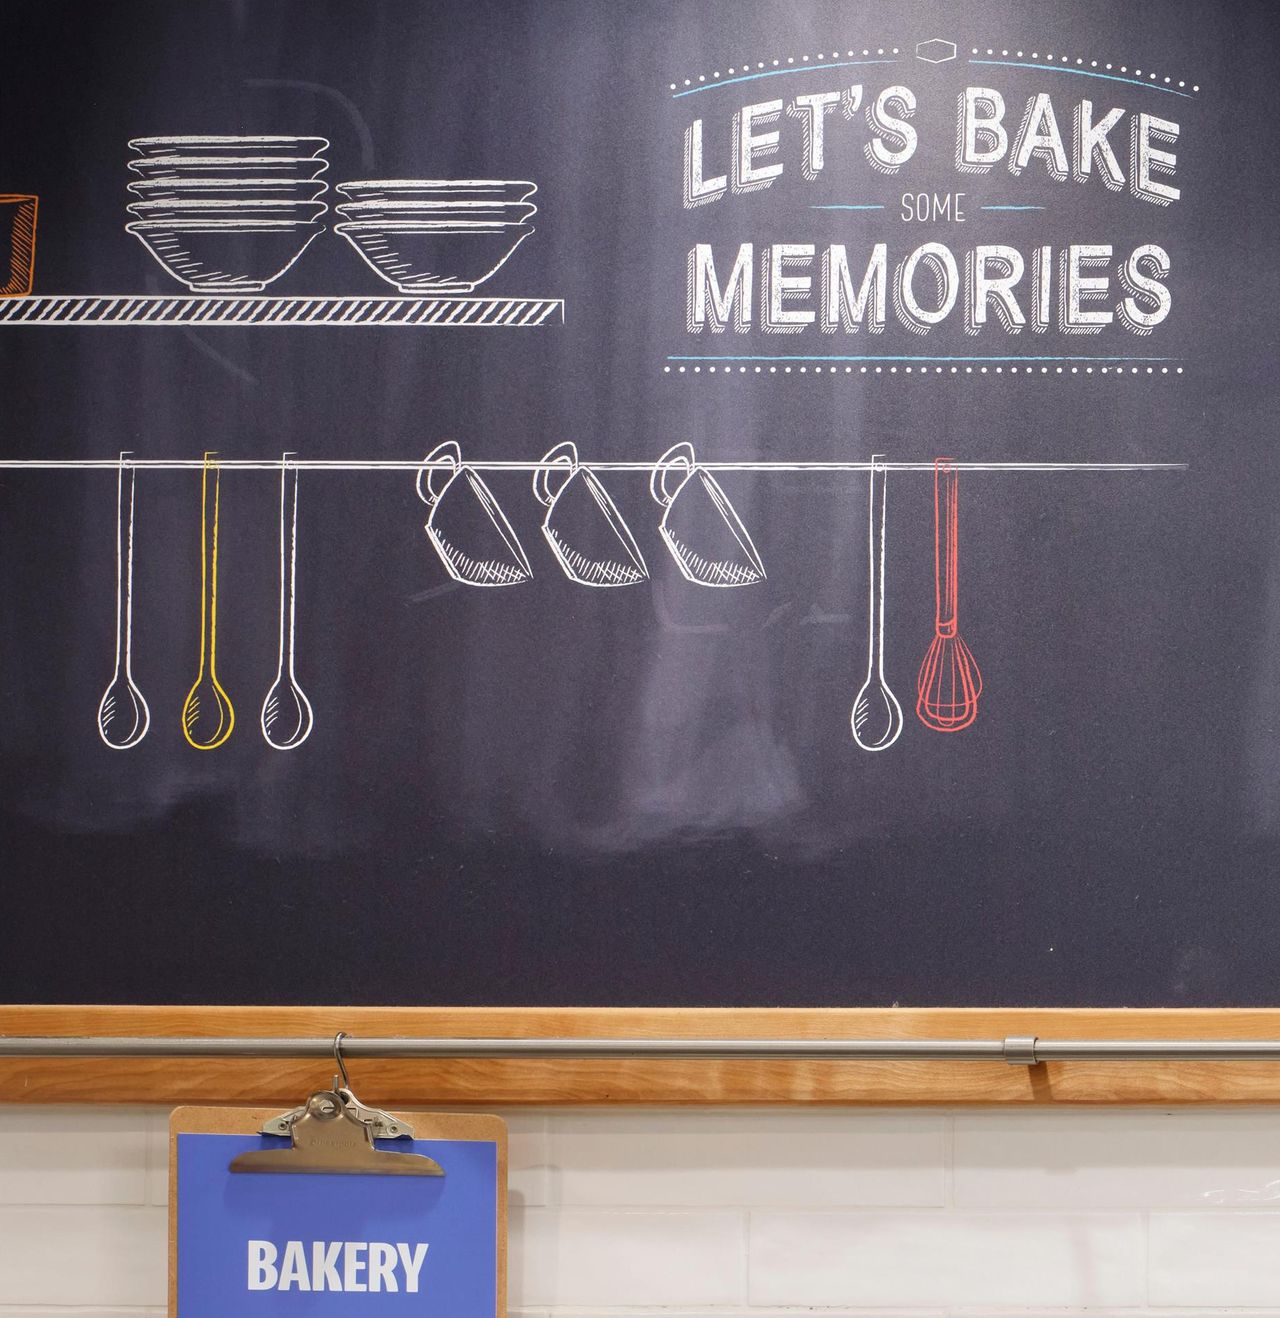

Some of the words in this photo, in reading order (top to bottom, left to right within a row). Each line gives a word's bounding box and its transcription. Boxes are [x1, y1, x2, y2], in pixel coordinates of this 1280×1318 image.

[684, 85, 918, 208] LET'S
[955, 86, 1181, 207] BAKE
[900, 192, 966, 223] SOME
[687, 242, 1172, 335] MEMORIES
[247, 1240, 429, 1293] BAKERY
